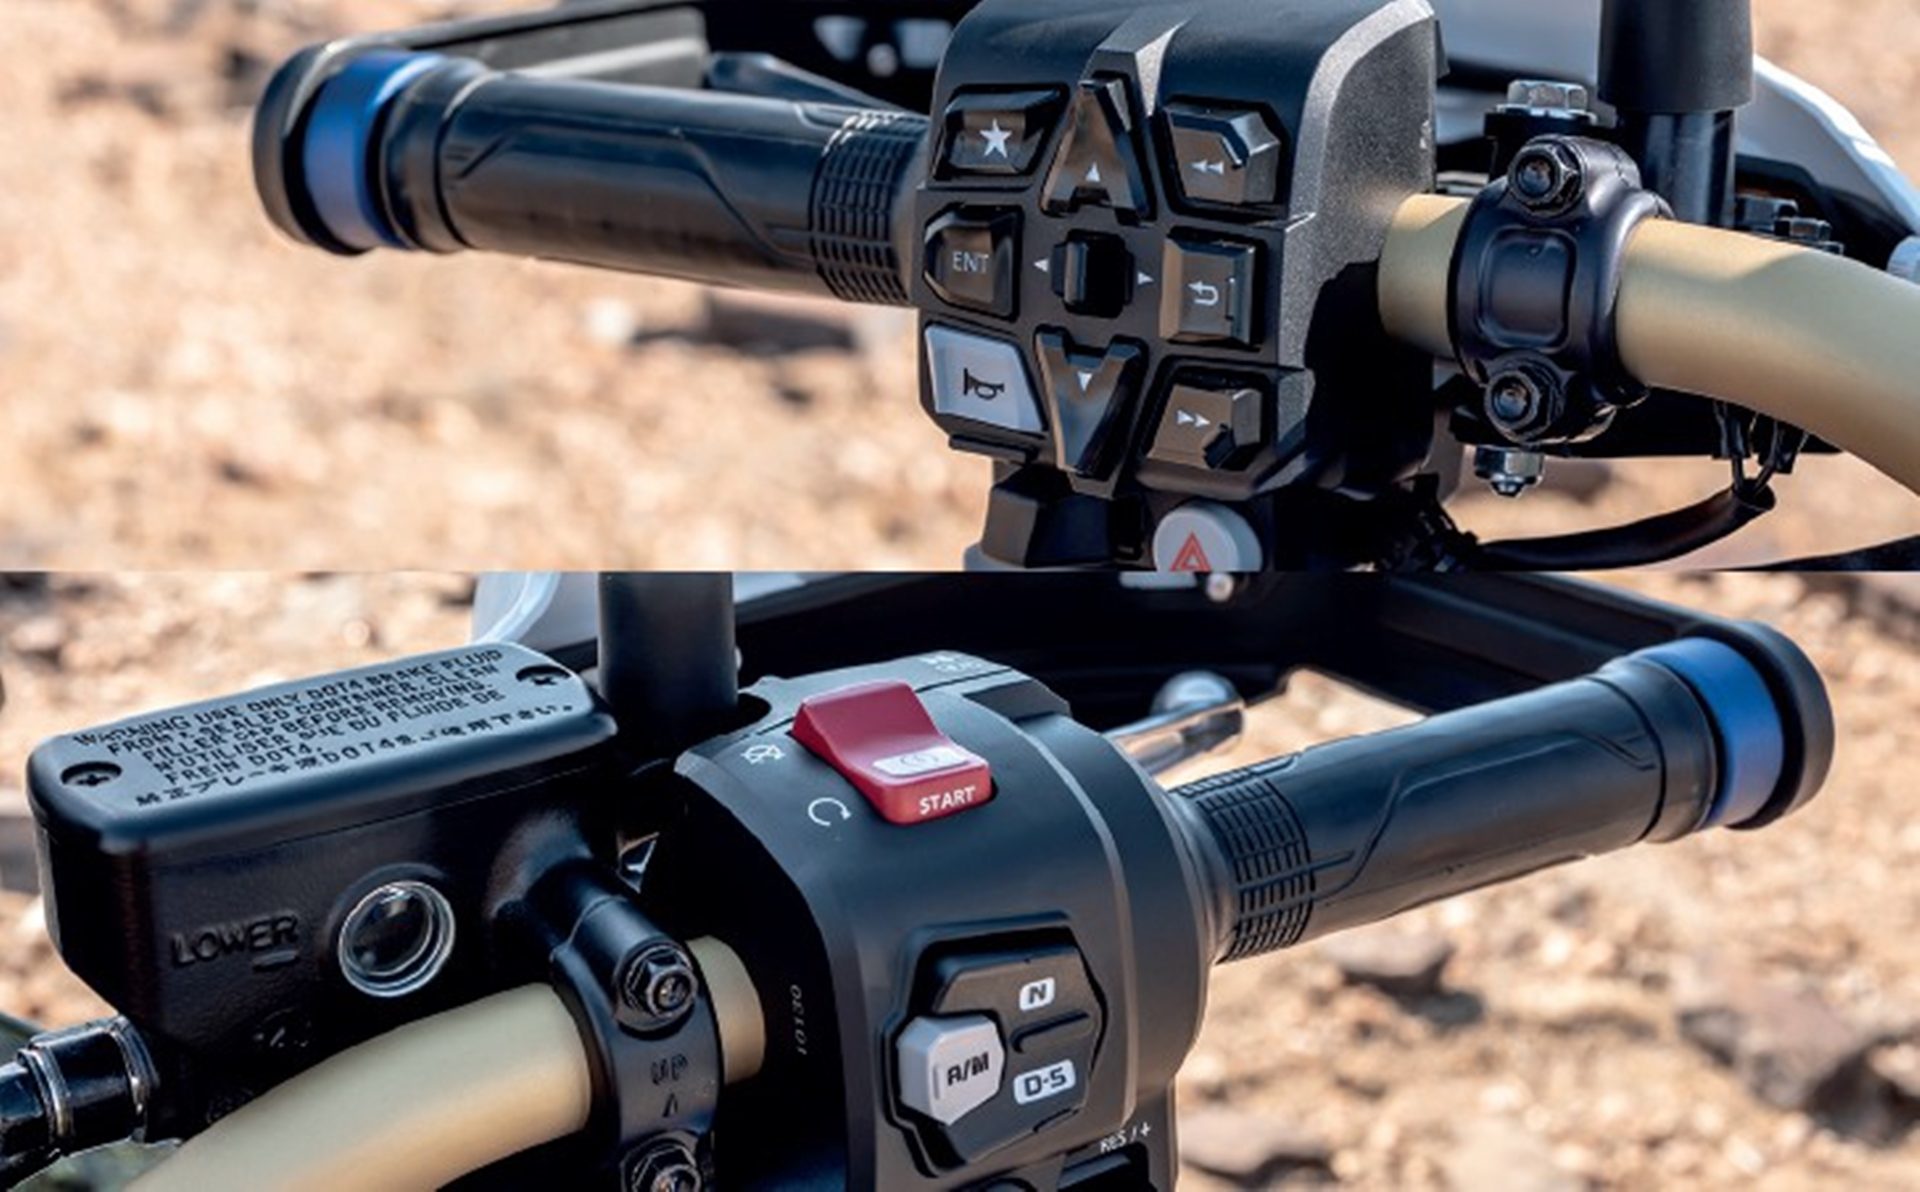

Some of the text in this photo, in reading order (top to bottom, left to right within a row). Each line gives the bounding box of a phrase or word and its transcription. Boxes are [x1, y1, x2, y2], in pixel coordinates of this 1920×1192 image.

[951, 249, 990, 274] ENT
[73, 716, 191, 747] WARNING
[193, 705, 244, 726] USE
[247, 692, 301, 713] ONLY
[306, 677, 363, 700] DOT4
[365, 662, 437, 686] BRAKE
[440, 650, 503, 671] FLUID
[107, 731, 174, 757] FROM
[198, 709, 290, 739] SEALED
[427, 664, 500, 687] CLEAN
[350, 716, 382, 733] DU
[386, 697, 469, 724] FLUIDE
[474, 689, 507, 705] DE
[142, 737, 228, 763] FILLER
[282, 704, 370, 734] BEFORE
[164, 759, 242, 786] FREIN
[918, 785, 977, 815] START
[170, 911, 299, 967] LOWER
[1027, 982, 1047, 1004] N
[946, 1051, 991, 1087] A/M
